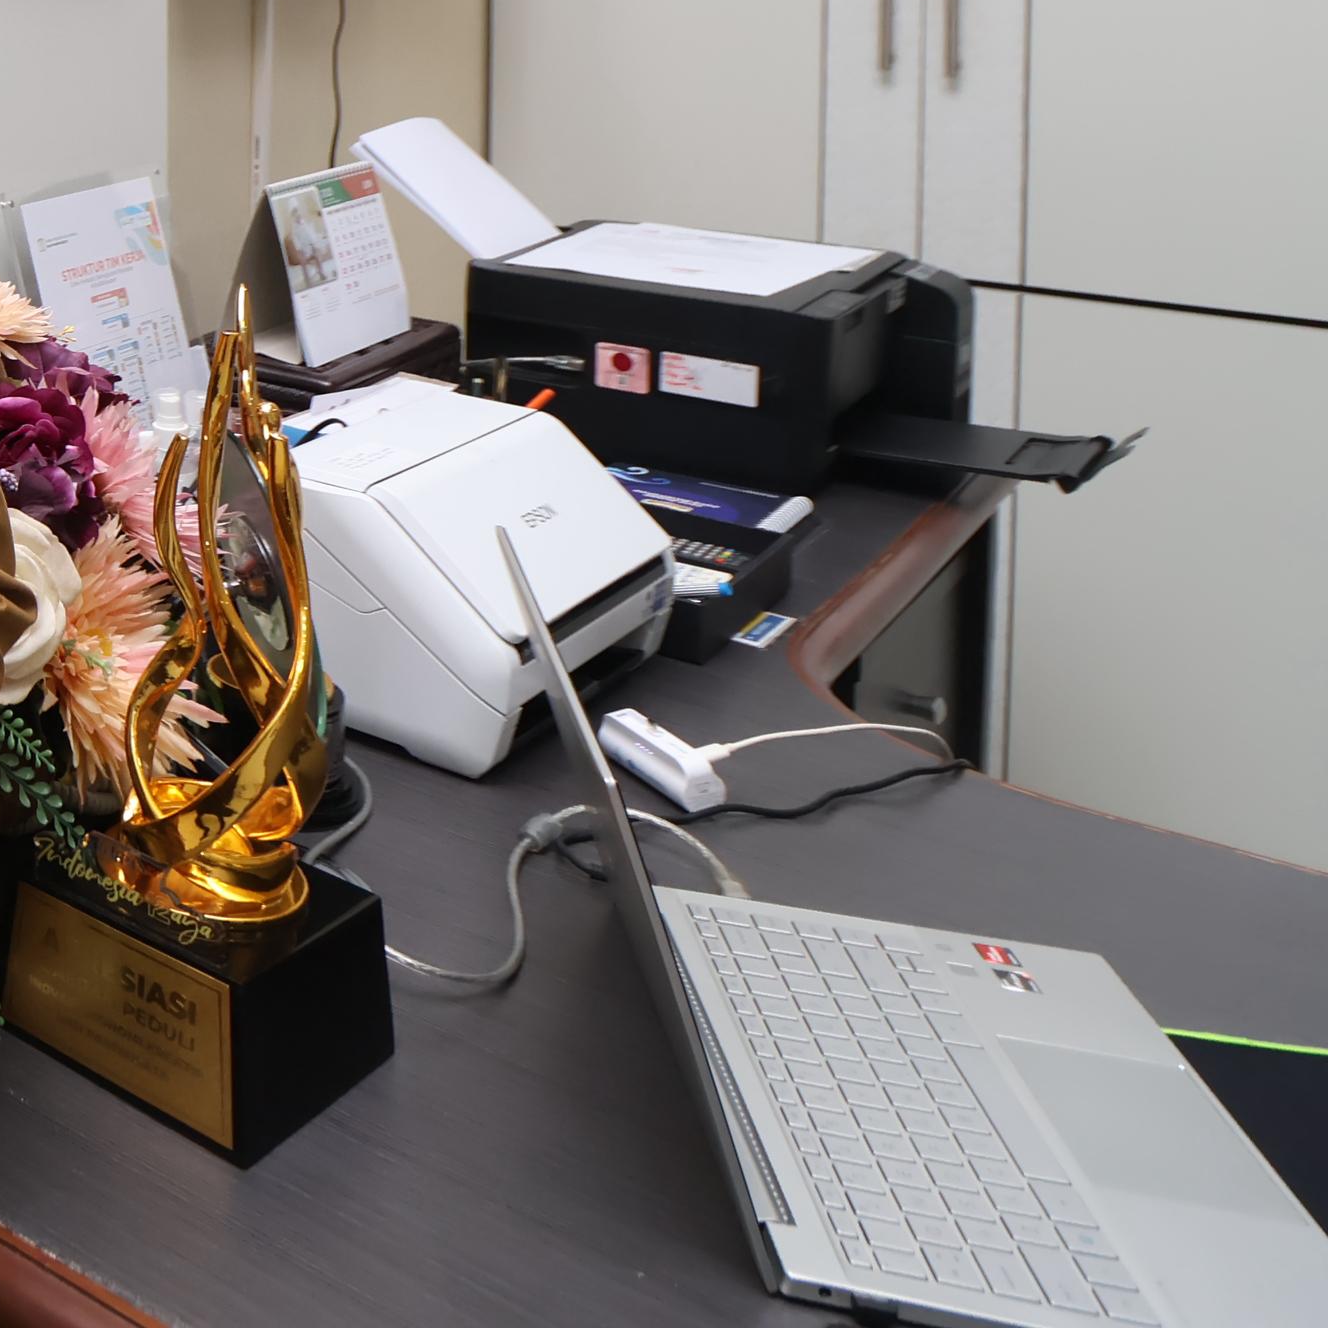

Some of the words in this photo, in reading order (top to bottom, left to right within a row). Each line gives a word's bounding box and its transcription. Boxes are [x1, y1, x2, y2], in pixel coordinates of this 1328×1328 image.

[33, 835, 143, 905] Indonesia
[146, 902, 214, 946] Raya
[122, 1003, 195, 1051] PEDULI
